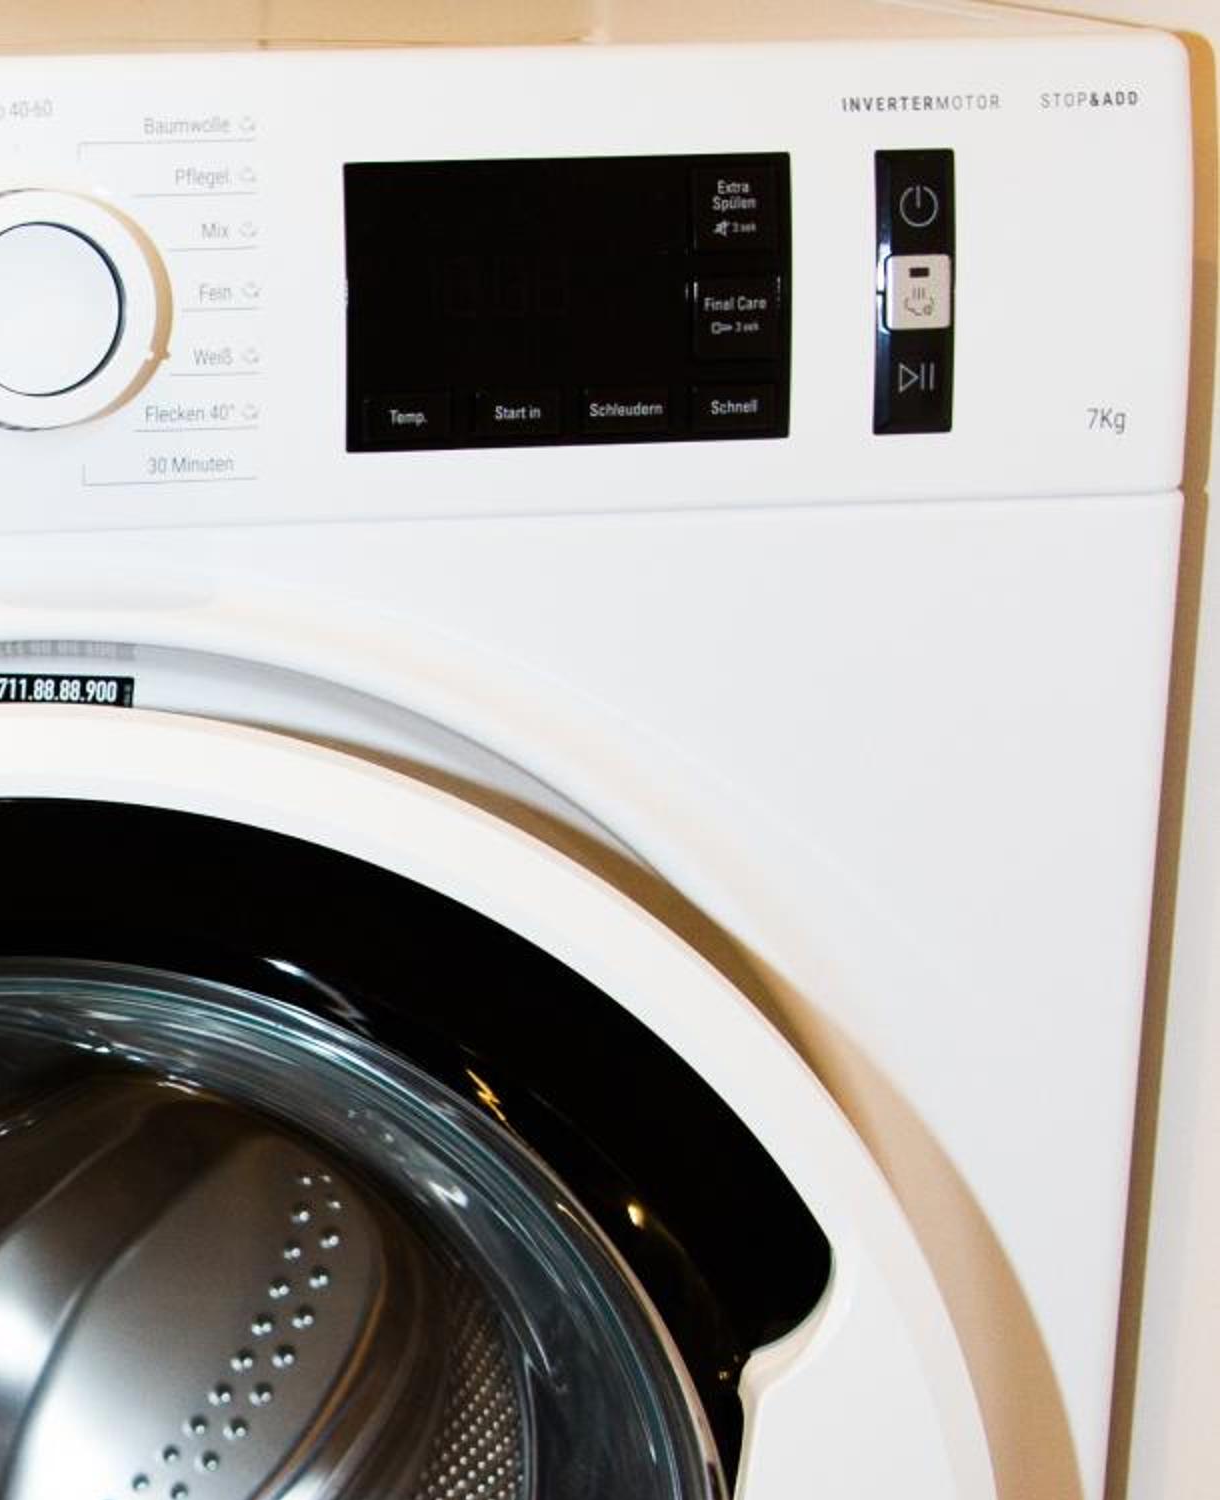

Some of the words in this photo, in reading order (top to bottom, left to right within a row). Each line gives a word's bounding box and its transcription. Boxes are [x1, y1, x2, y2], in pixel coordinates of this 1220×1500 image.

[842, 95, 1001, 112] INVERTERMOTOR
[1041, 91, 1139, 109] STOP&ADD
[143, 117, 230, 136] Baumwolle
[717, 180, 750, 194] Extra
[712, 196, 756, 212] Spülen
[202, 222, 229, 240] Mix
[199, 285, 232, 302] Fein
[704, 297, 734, 311] Final
[737, 296, 767, 310] Care
[193, 348, 233, 367] Weiß
[145, 405, 206, 424] Flecken
[494, 405, 526, 421] Start
[529, 404, 541, 419] in
[590, 401, 663, 418] Schleudern
[711, 400, 758, 415] Schnell
[390, 409, 428, 425] Temp.
[1087, 408, 1126, 433] 7Kg
[147, 457, 167, 475] 30
[171, 454, 233, 474] Minuten
